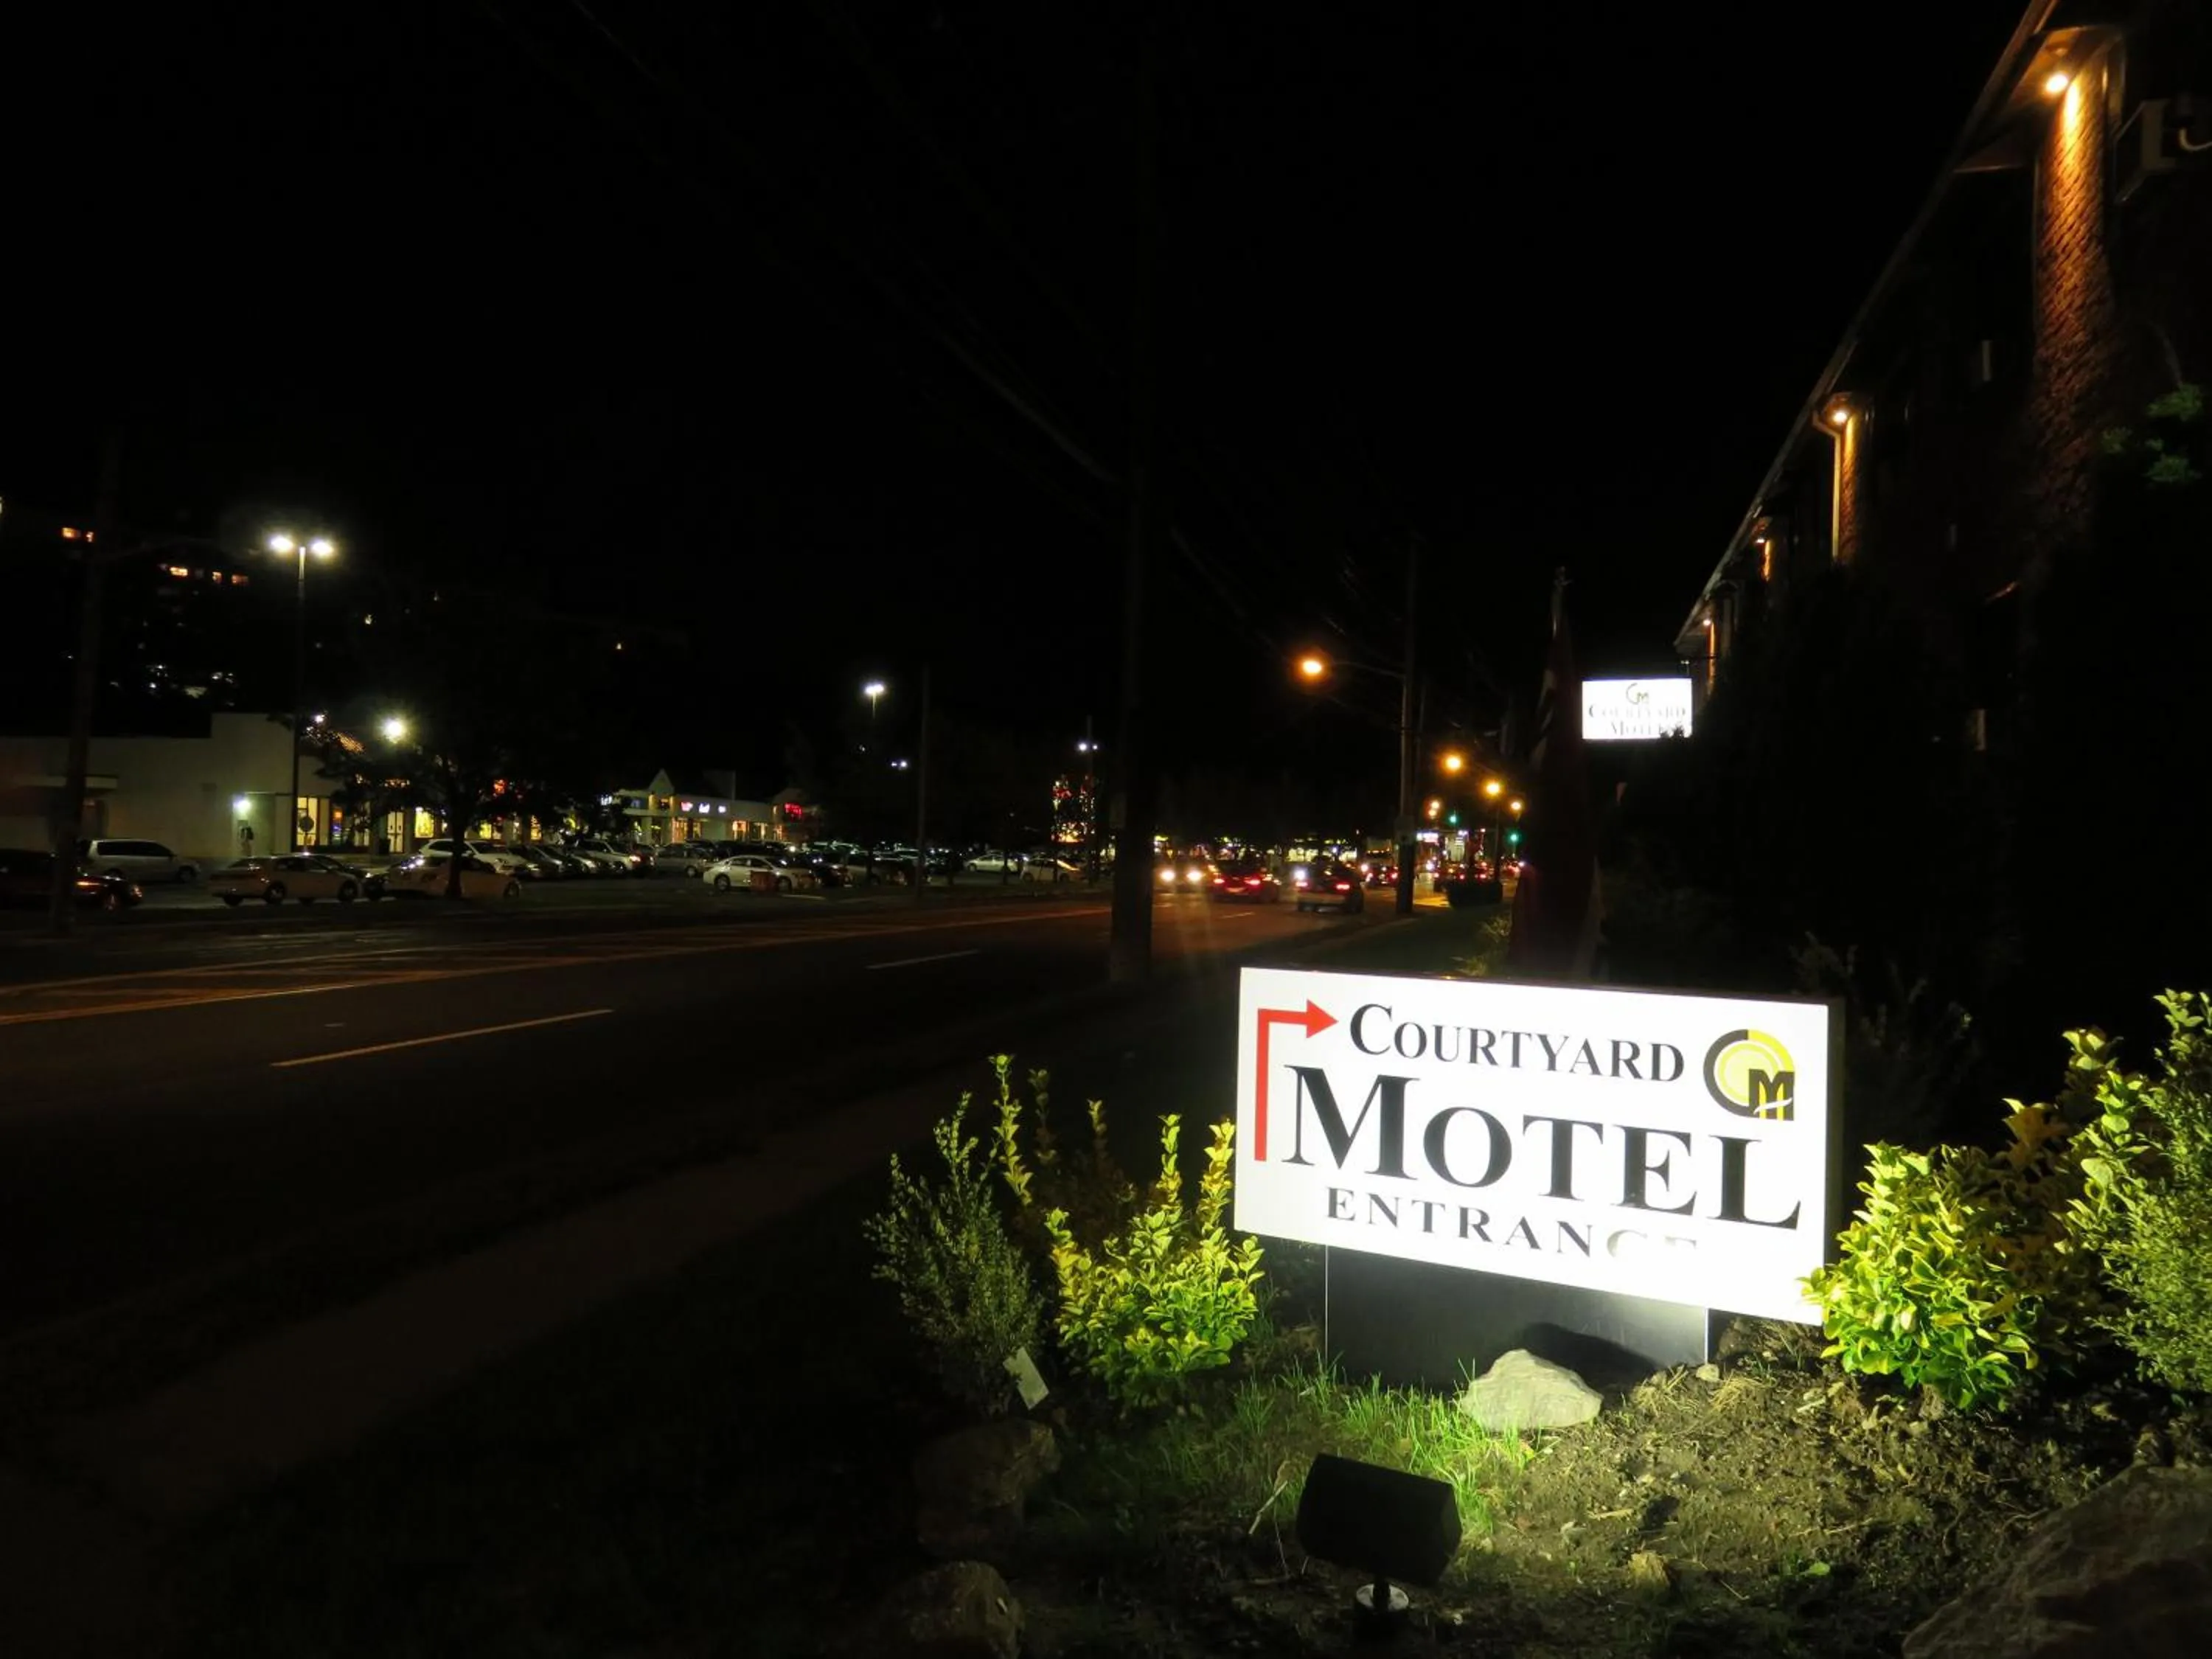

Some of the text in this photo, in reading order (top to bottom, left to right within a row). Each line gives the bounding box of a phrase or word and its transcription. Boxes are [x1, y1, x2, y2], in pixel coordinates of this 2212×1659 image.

[1349, 1002, 1685, 1084] COURTYARD
[1281, 1063, 1802, 1231] MOTEL
[1326, 1186, 1699, 1260] ENTRANC
